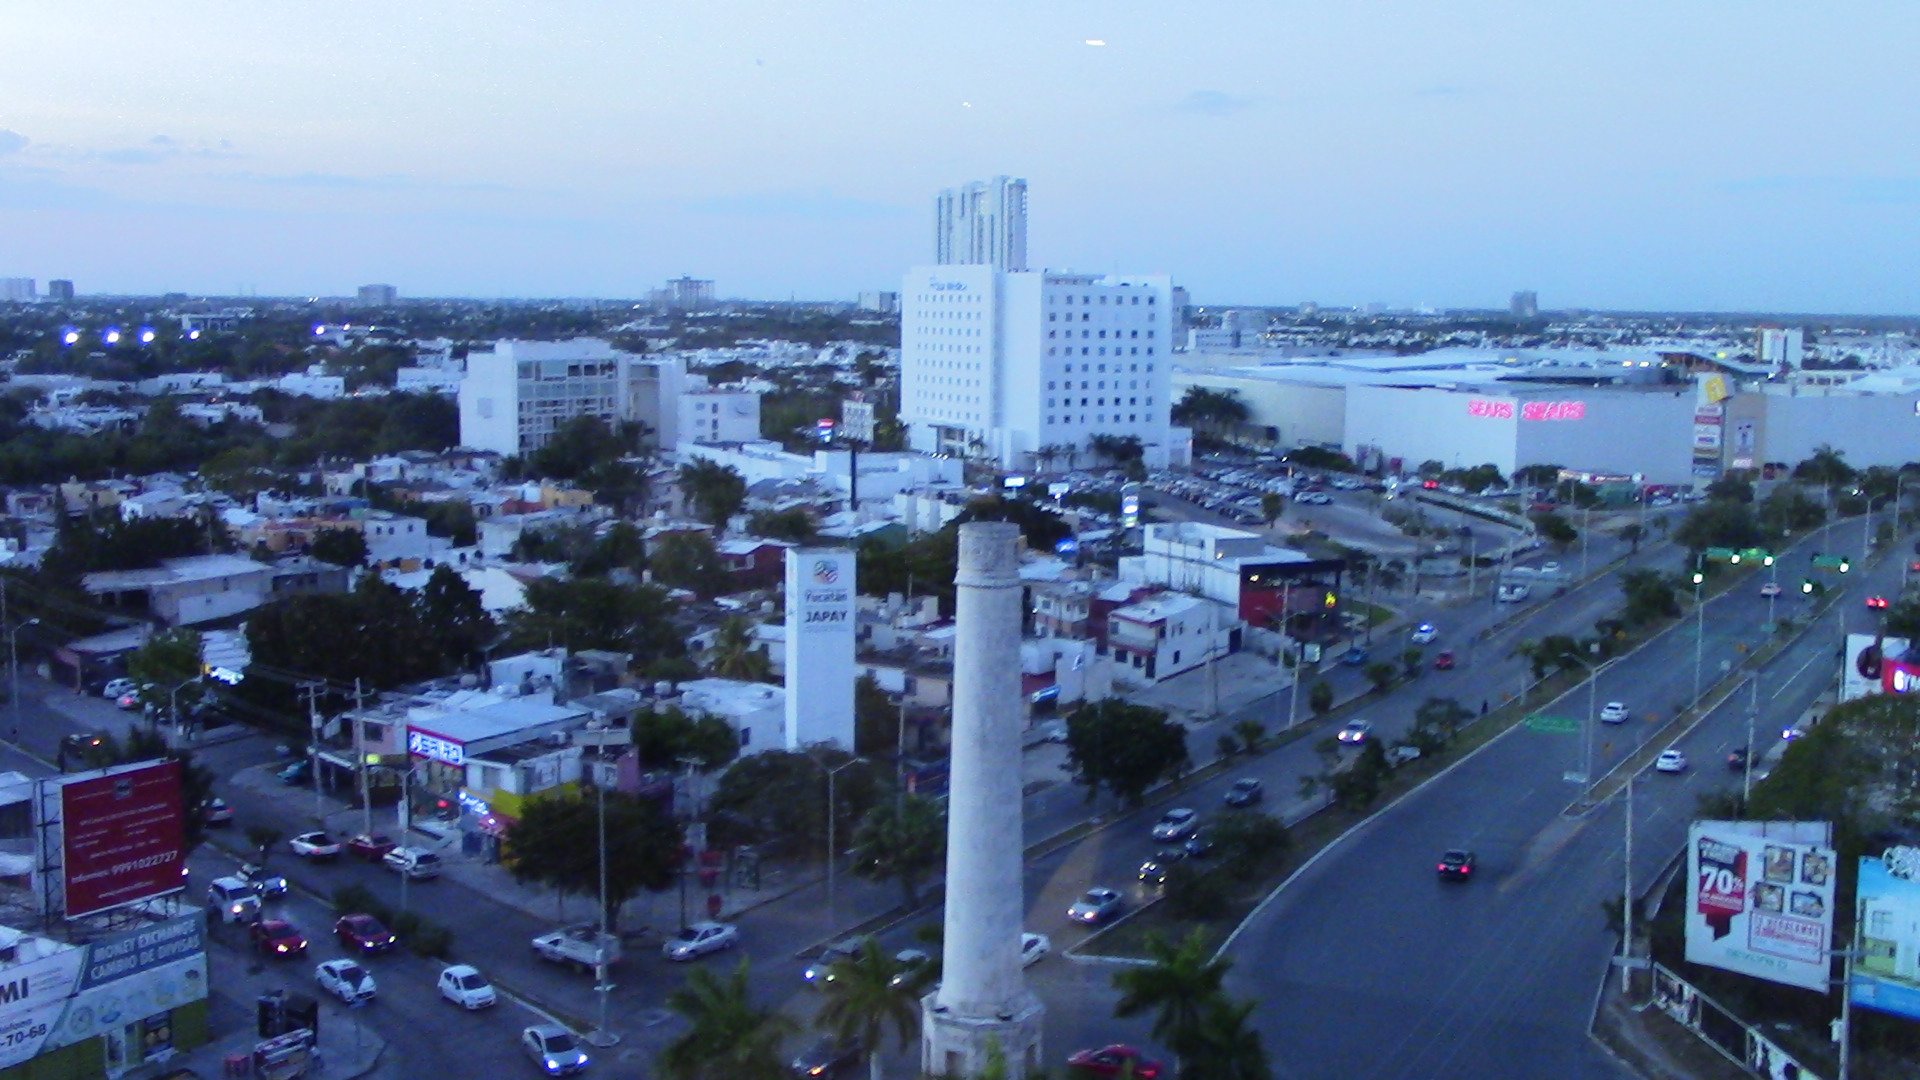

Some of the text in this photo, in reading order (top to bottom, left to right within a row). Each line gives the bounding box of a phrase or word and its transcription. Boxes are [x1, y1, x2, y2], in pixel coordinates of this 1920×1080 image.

[1467, 400, 1515, 419] SEARS
[1521, 401, 1586, 421] SEARS
[804, 610, 848, 623] JAPAY
[91, 954, 138, 980] CAMBIO
